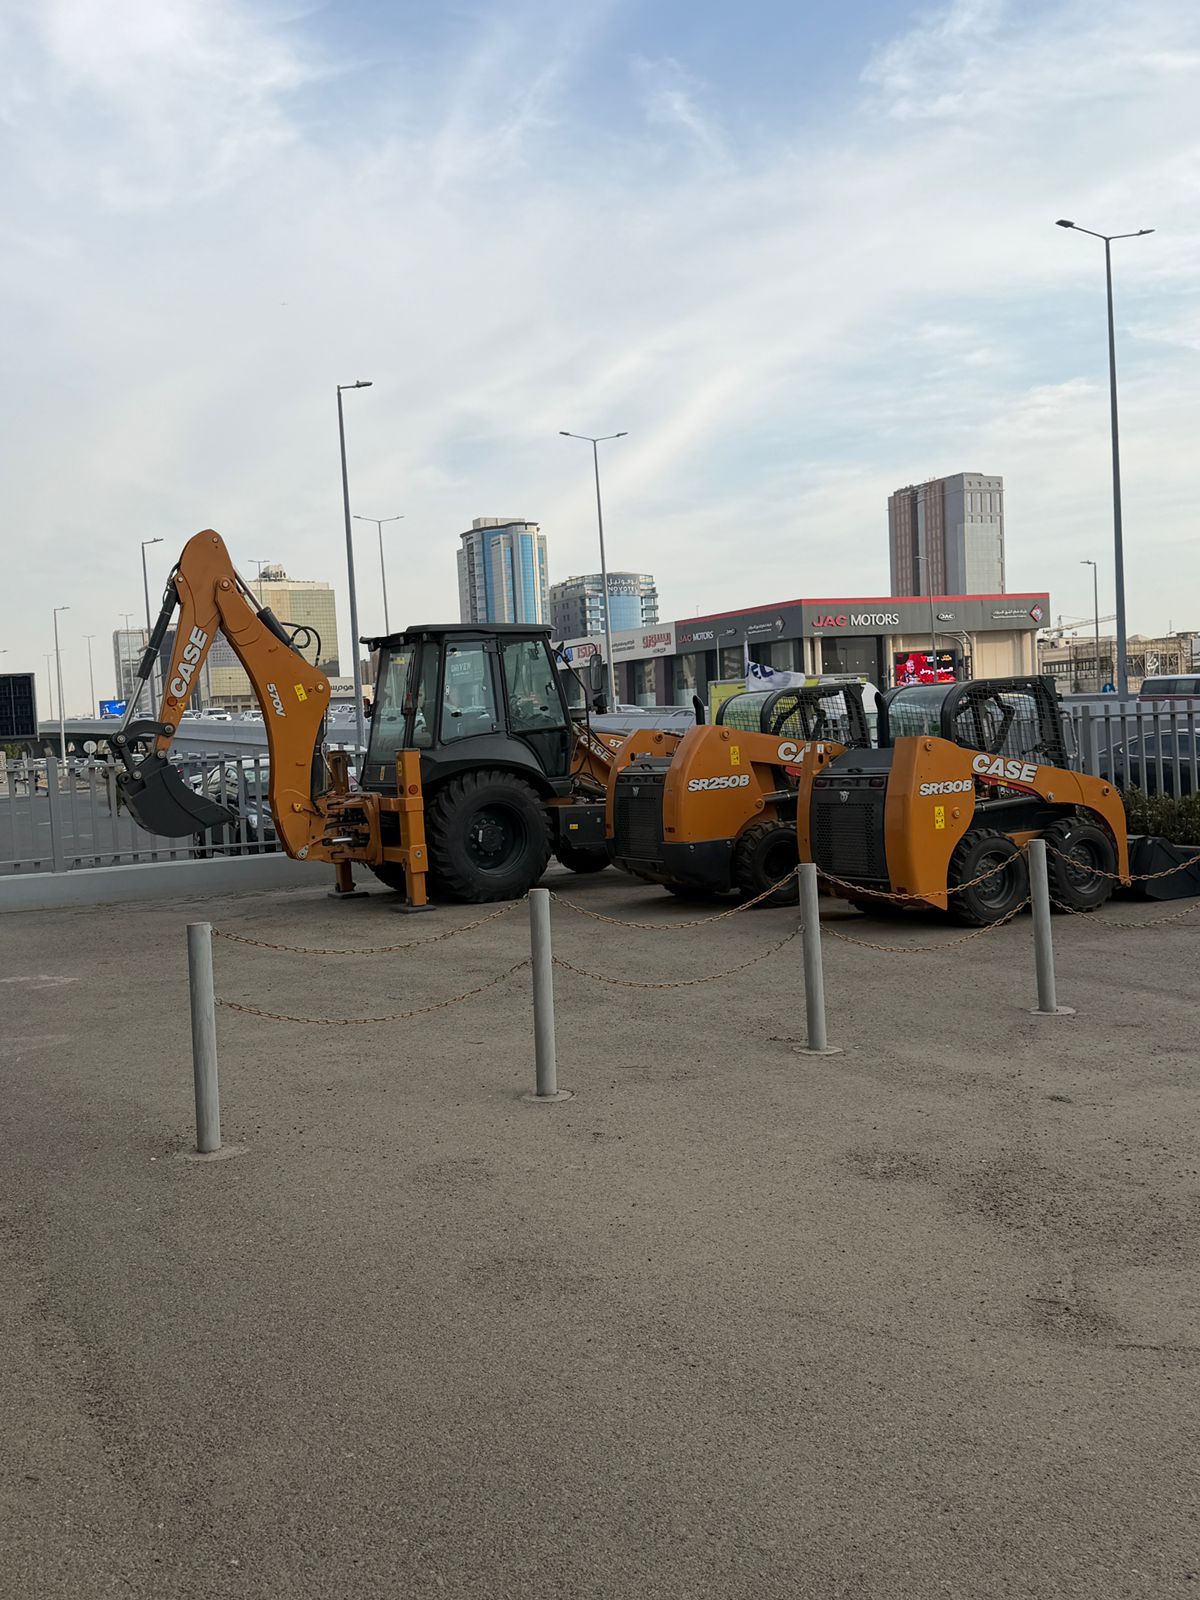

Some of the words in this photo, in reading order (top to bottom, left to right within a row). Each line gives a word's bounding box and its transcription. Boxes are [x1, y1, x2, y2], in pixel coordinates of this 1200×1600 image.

[813, 615, 848, 627] JAC
[850, 613, 899, 626] MOTORS
[692, 630, 714, 641] MOTORS
[170, 625, 208, 698] CASE
[266, 682, 287, 718] 570V
[609, 738, 623, 748] 57
[972, 753, 1038, 783] CASE
[688, 774, 750, 792] SR250B
[920, 779, 973, 796] SR130B
